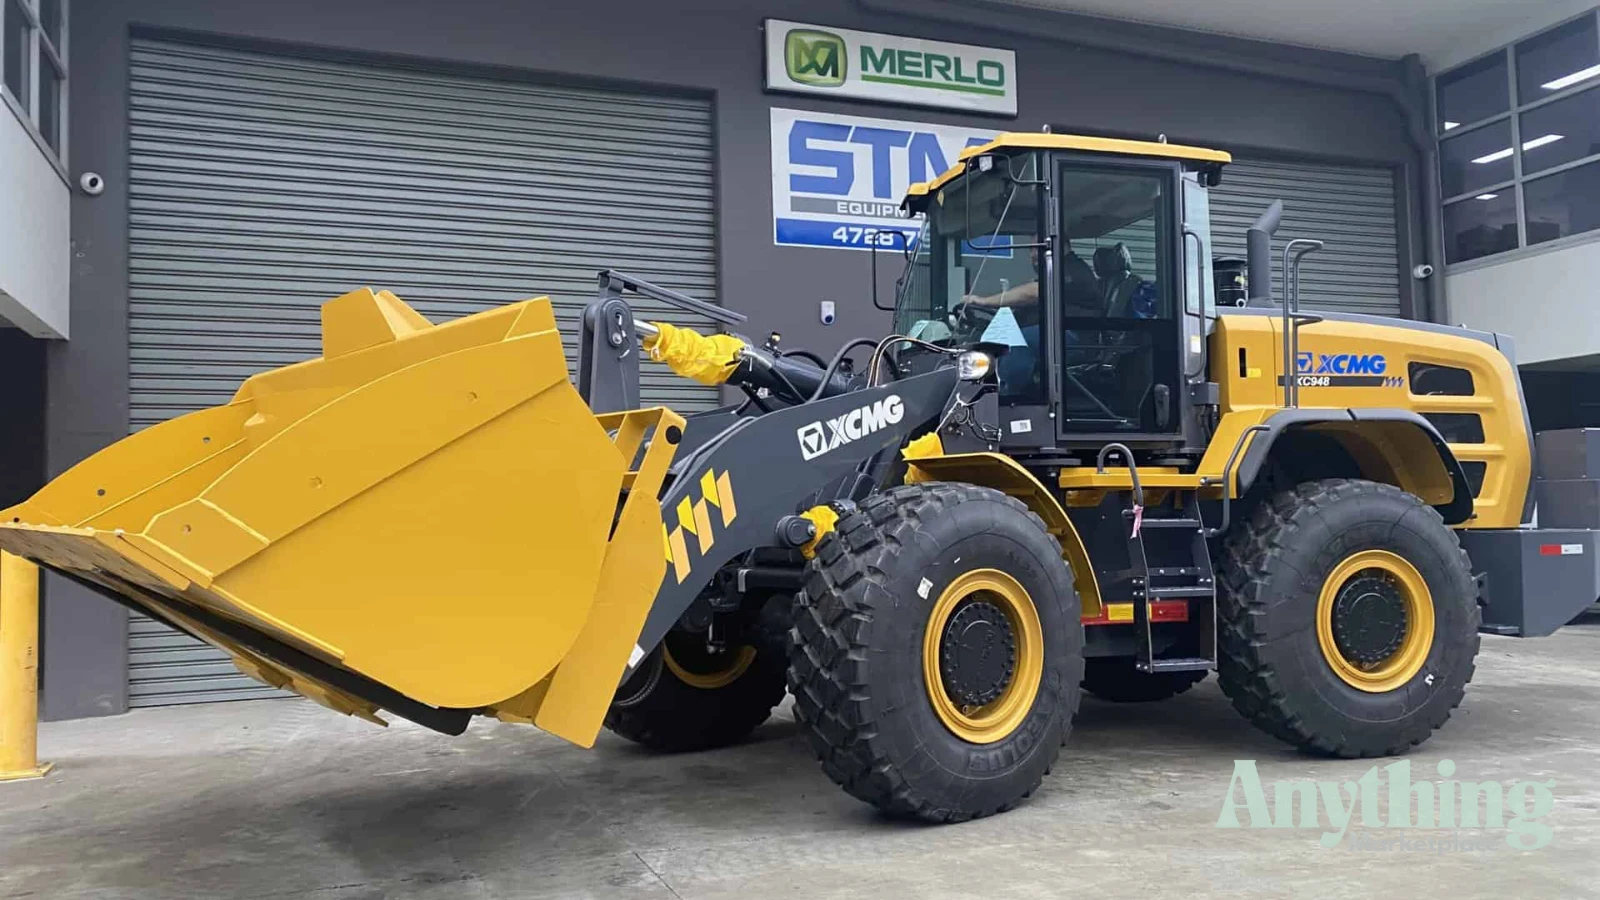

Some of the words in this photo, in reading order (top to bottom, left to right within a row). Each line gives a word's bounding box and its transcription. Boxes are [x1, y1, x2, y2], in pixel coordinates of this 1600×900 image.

[860, 45, 1005, 87] MERLO
[833, 226, 894, 246] 4728
[1315, 353, 1386, 375] XCMG
[826, 395, 904, 450] XCMG
